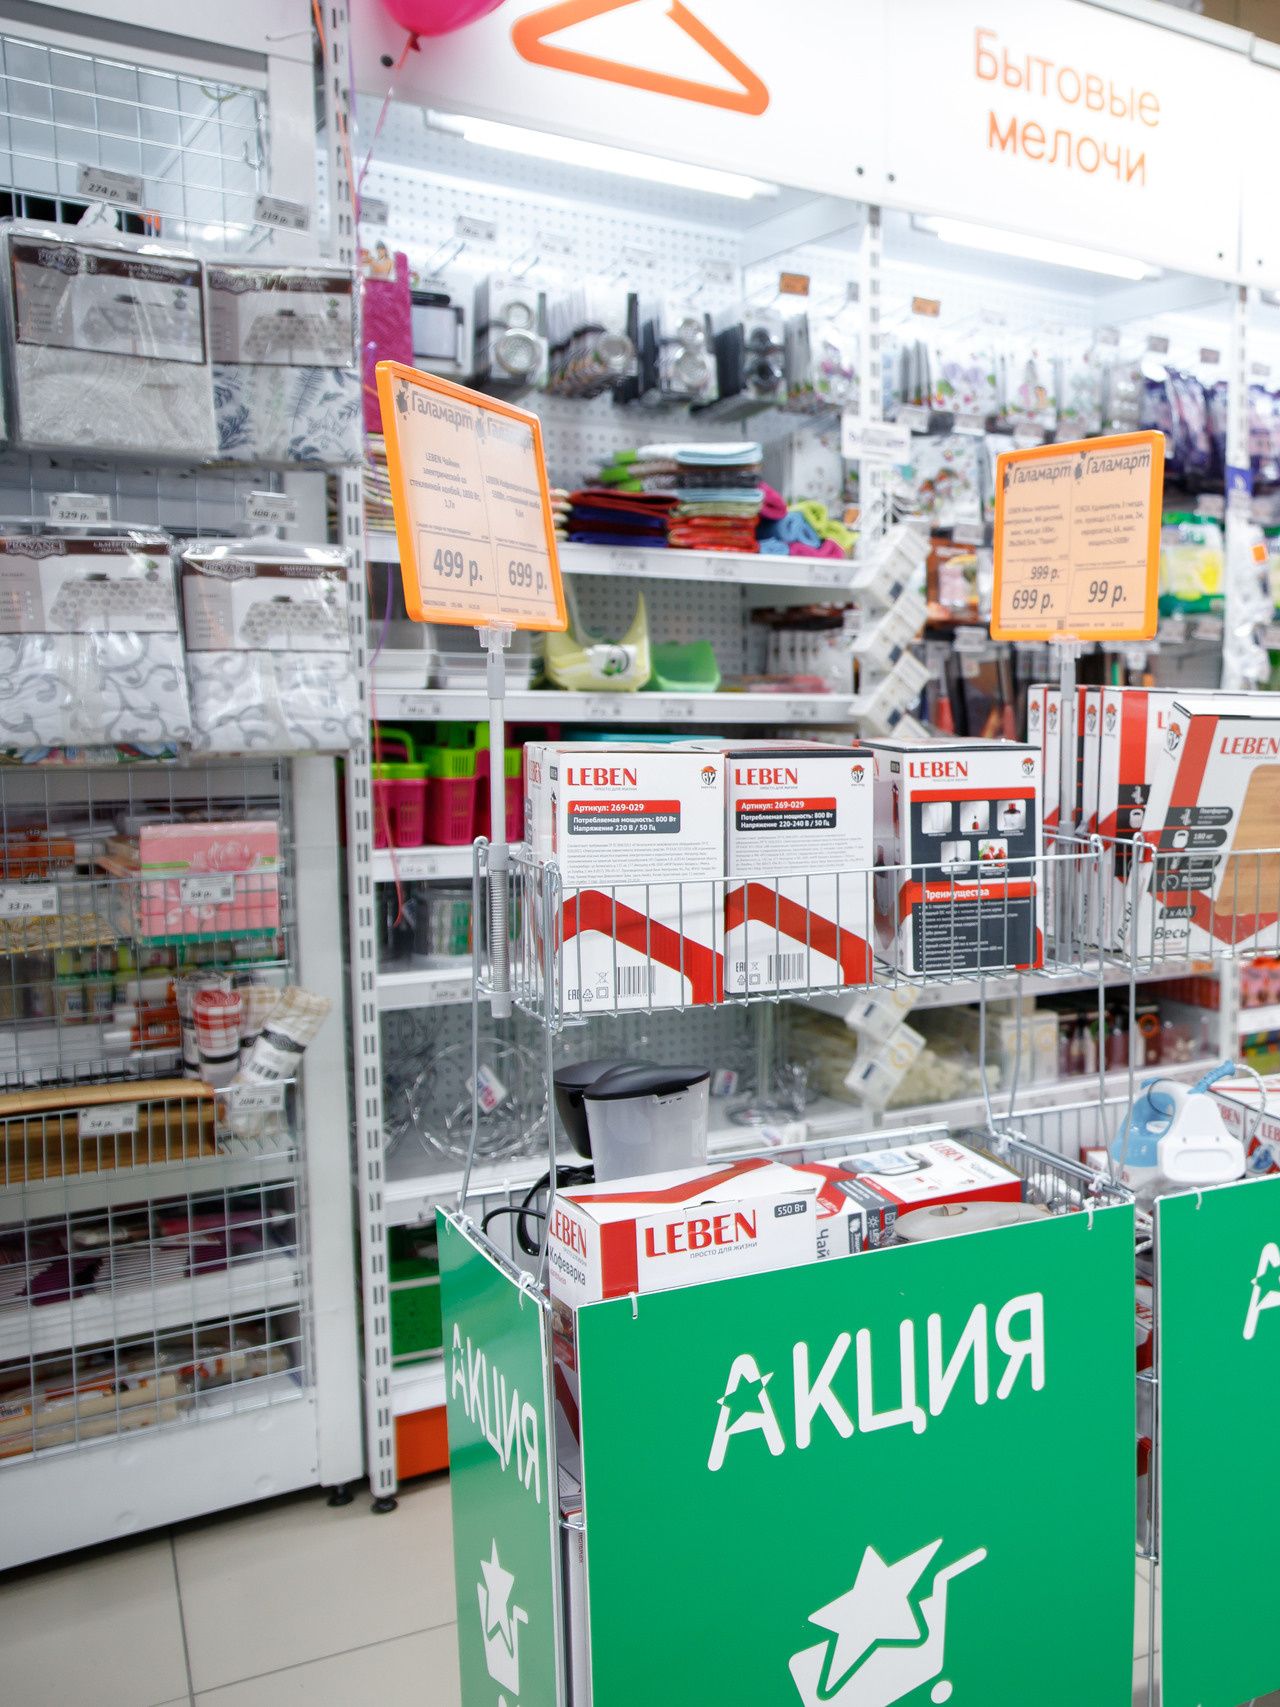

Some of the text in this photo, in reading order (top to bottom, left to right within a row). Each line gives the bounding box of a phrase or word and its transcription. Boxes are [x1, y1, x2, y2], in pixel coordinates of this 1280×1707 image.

[972, 26, 1162, 128] Бытовые
[988, 110, 1147, 188] мелочи
[411, 391, 474, 432] Галамарт
[1013, 464, 1071, 485] Галамарт
[1086, 454, 1150, 475] Галамарт
[433, 549, 483, 587] 499 р.
[508, 560, 548, 595] 699 р.
[1030, 565, 1061, 582] 999 р.
[1012, 588, 1054, 614] 699 р.
[1087, 579, 1127, 608] 99 р.
[1220, 737, 1280, 755] LEBEN
[567, 768, 637, 786] LEBEN
[735, 768, 798, 785] LEBEN
[909, 761, 968, 778] LEBEN
[574, 803, 644, 813] Артикул: 269-029
[741, 802, 773, 810] Артикул:
[573, 816, 620, 824] Потребляемая
[621, 816, 655, 824] мощность:
[741, 821, 777, 829] Напряжение
[1154, 927, 1190, 939] Весы
[777, 1203, 804, 1216] 550 Вт
[549, 1209, 587, 1258] LEBEN
[645, 1209, 757, 1258] LEBEN
[690, 1241, 758, 1259] ПРОСТО ДЛЯ ЖИЗНИ
[549, 1245, 586, 1286] Кофеварка
[707, 1291, 1046, 1472] АКЦИЯ
[452, 1323, 541, 1504] АКЦИЯ
